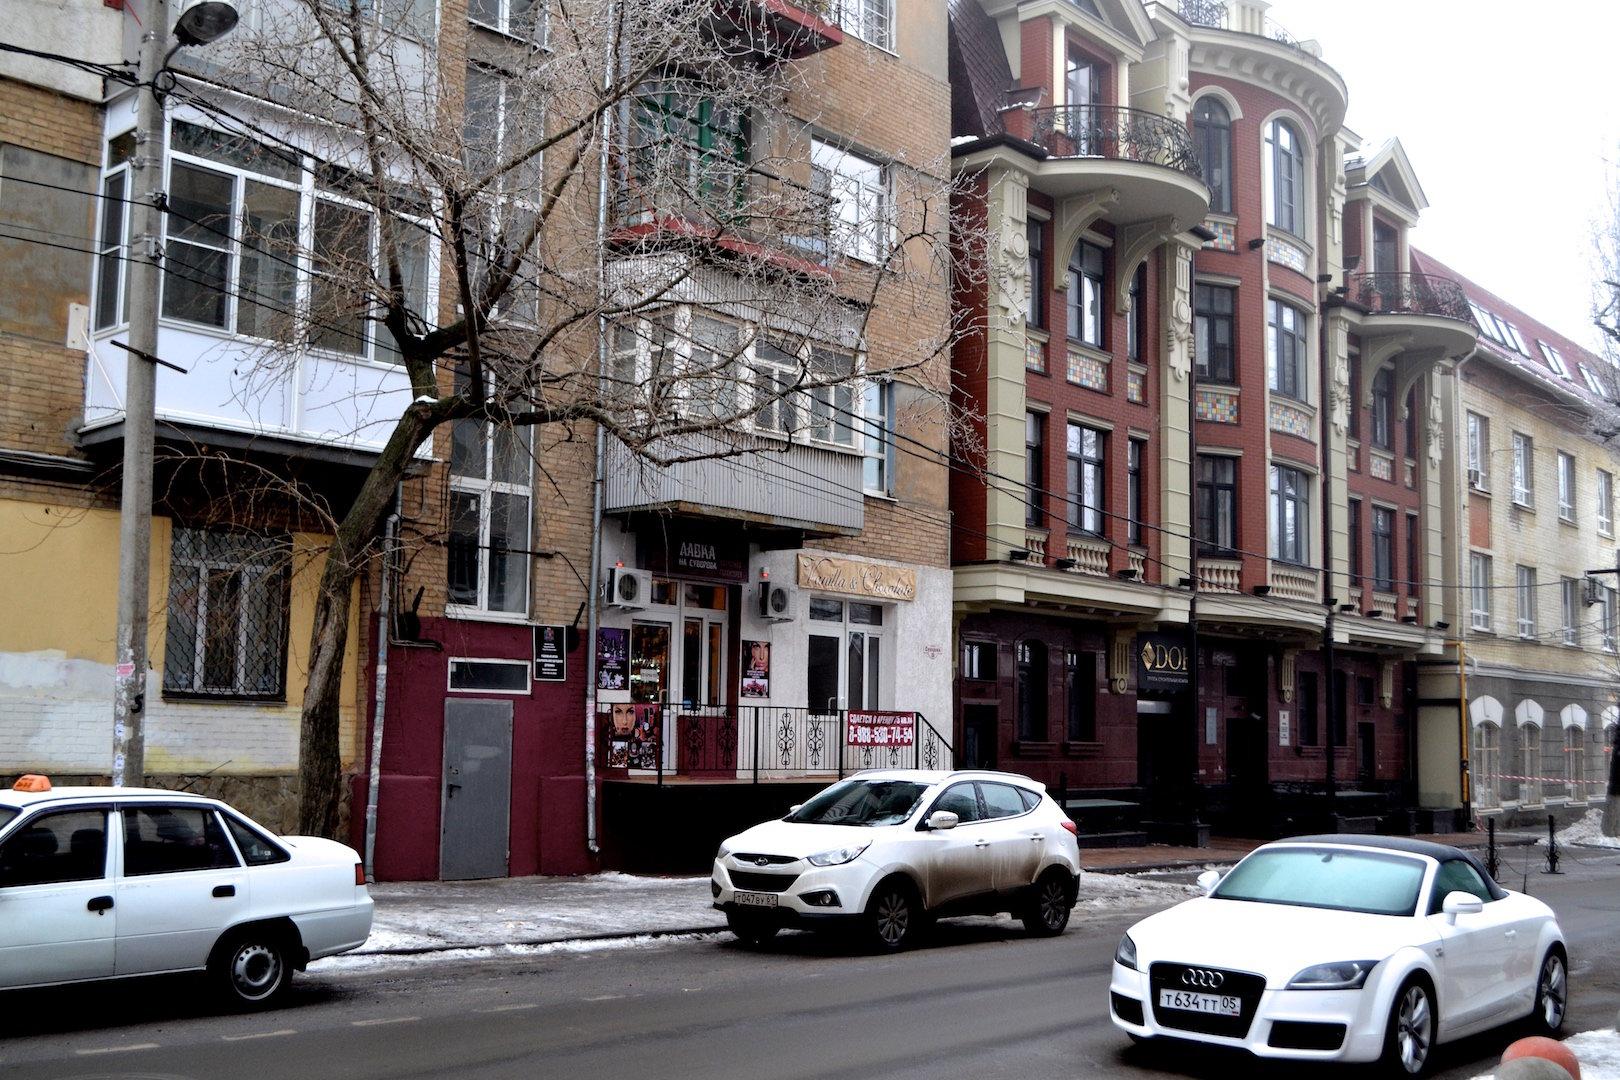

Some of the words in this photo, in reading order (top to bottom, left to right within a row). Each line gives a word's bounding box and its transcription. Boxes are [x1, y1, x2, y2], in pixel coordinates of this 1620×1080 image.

[680, 542, 716, 560] ЛАВКА
[1166, 992, 1218, 1011] Т634ТТ
[1222, 997, 1236, 1009] 05
